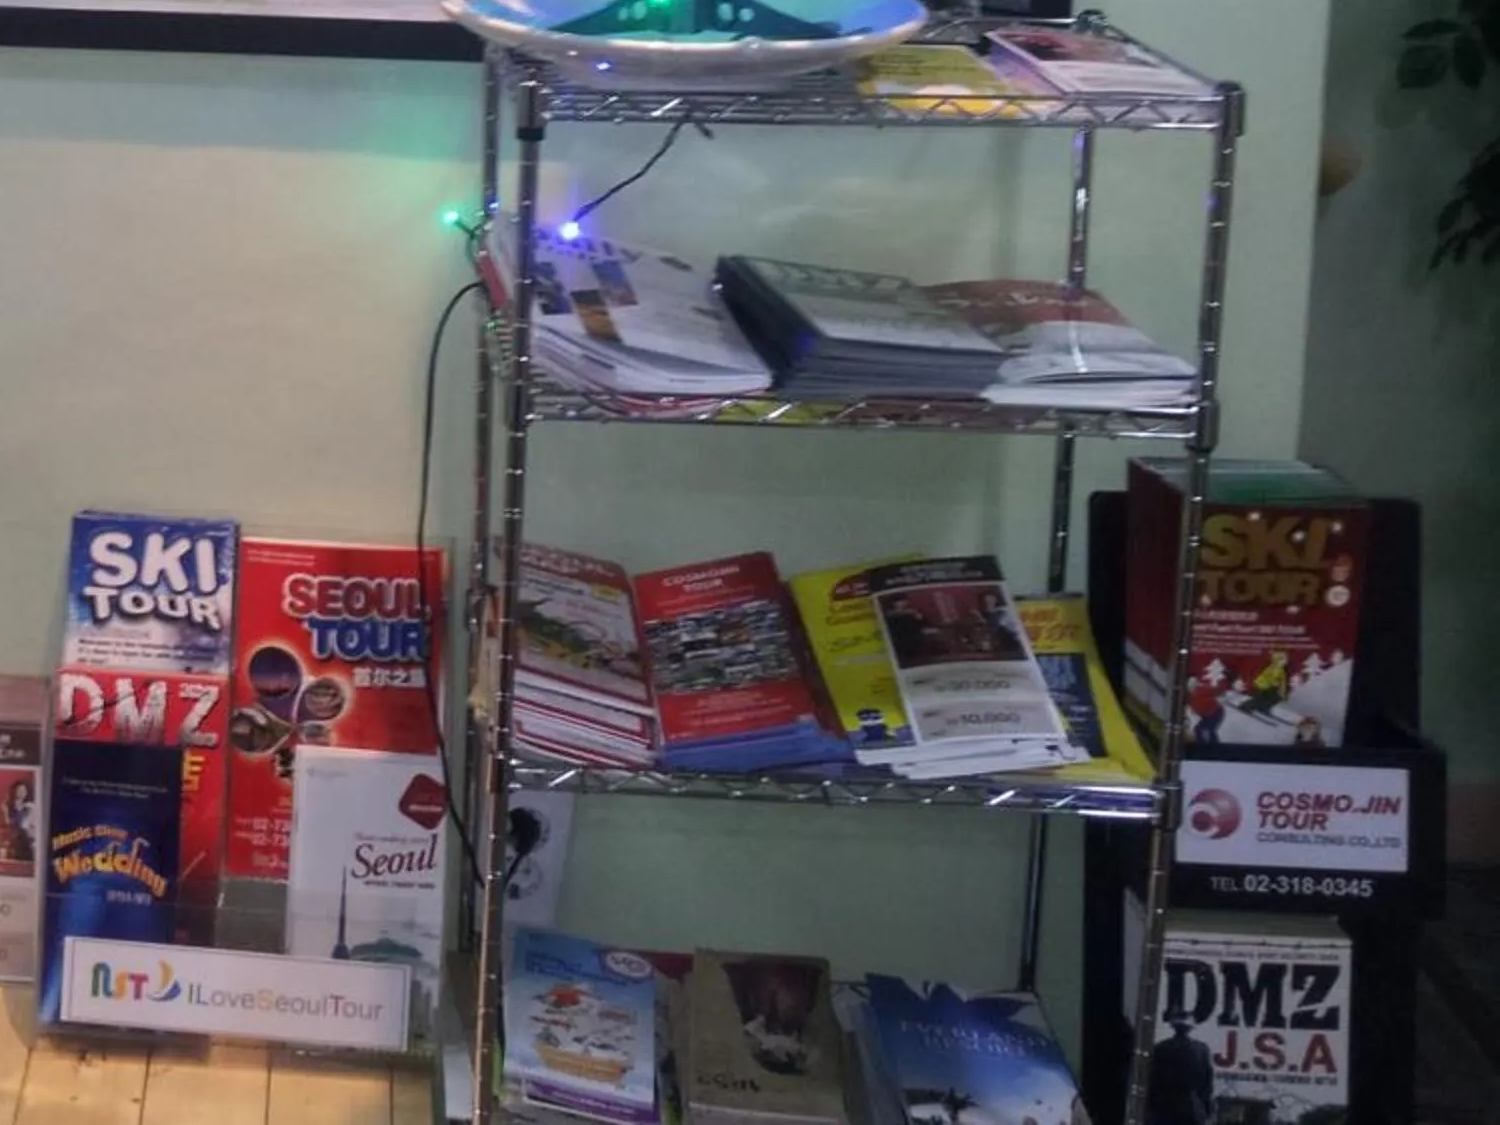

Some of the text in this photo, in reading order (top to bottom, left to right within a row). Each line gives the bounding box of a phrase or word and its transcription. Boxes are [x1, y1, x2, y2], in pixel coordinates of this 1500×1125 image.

[90, 531, 217, 594] SKI
[1201, 513, 1329, 568] SKI
[83, 585, 222, 631] TOUR
[284, 574, 431, 621] SEOUL
[1199, 571, 1321, 605] TOUR
[303, 618, 427, 660] TOUR
[59, 672, 220, 747] DMZ
[1257, 811, 1328, 831] TOUR
[52, 836, 168, 898] Wedding
[351, 833, 438, 879] Seoul
[1243, 875, 1374, 898] 02-318-0345
[1162, 959, 1341, 1031] DMZ
